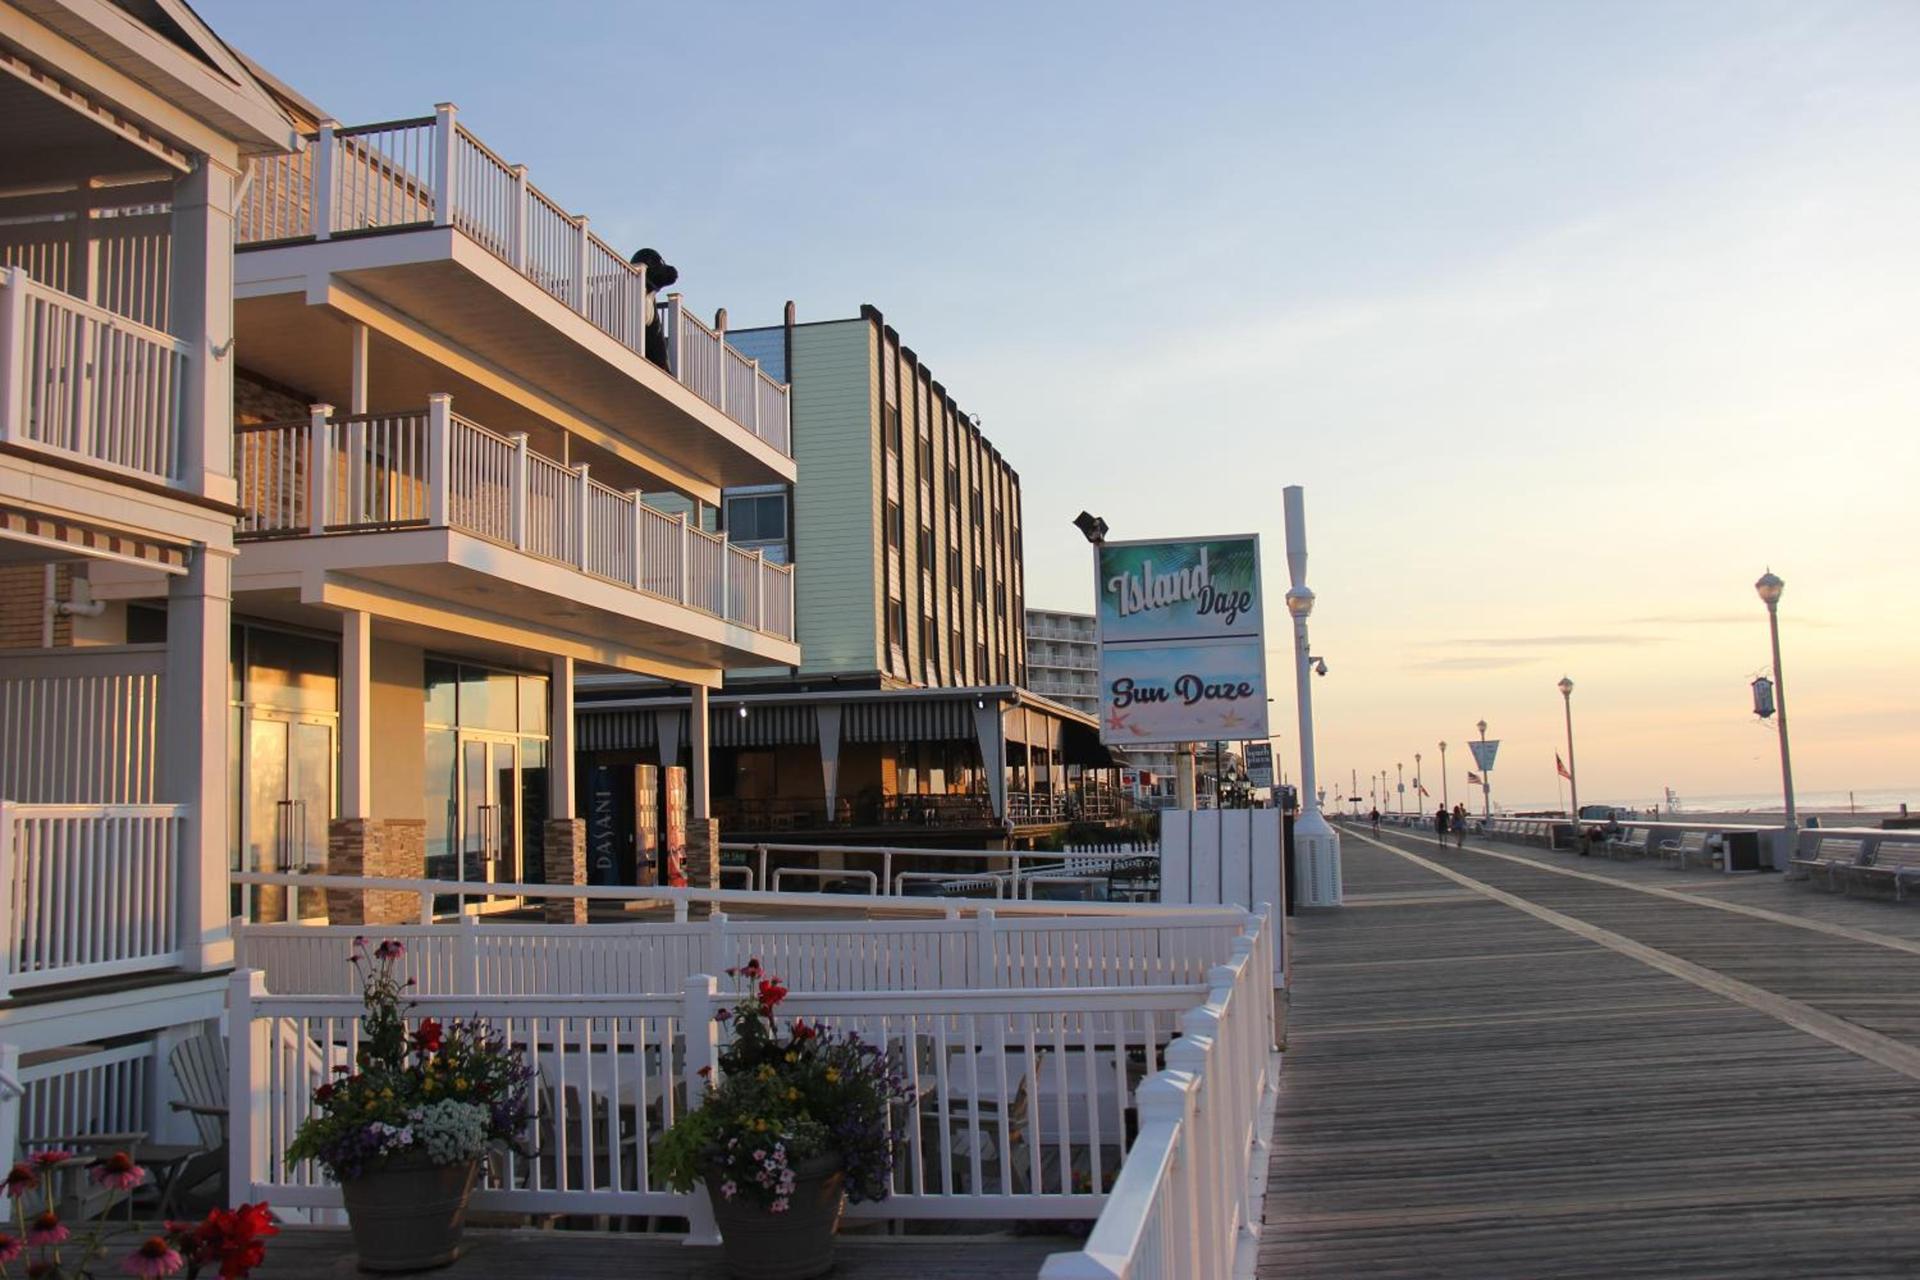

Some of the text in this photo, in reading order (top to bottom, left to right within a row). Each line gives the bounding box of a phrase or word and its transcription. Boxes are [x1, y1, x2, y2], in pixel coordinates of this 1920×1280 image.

[1108, 547, 1253, 626] Island Daze
[1112, 674, 1254, 708] Sun Daze
[594, 792, 615, 869] DASANI
